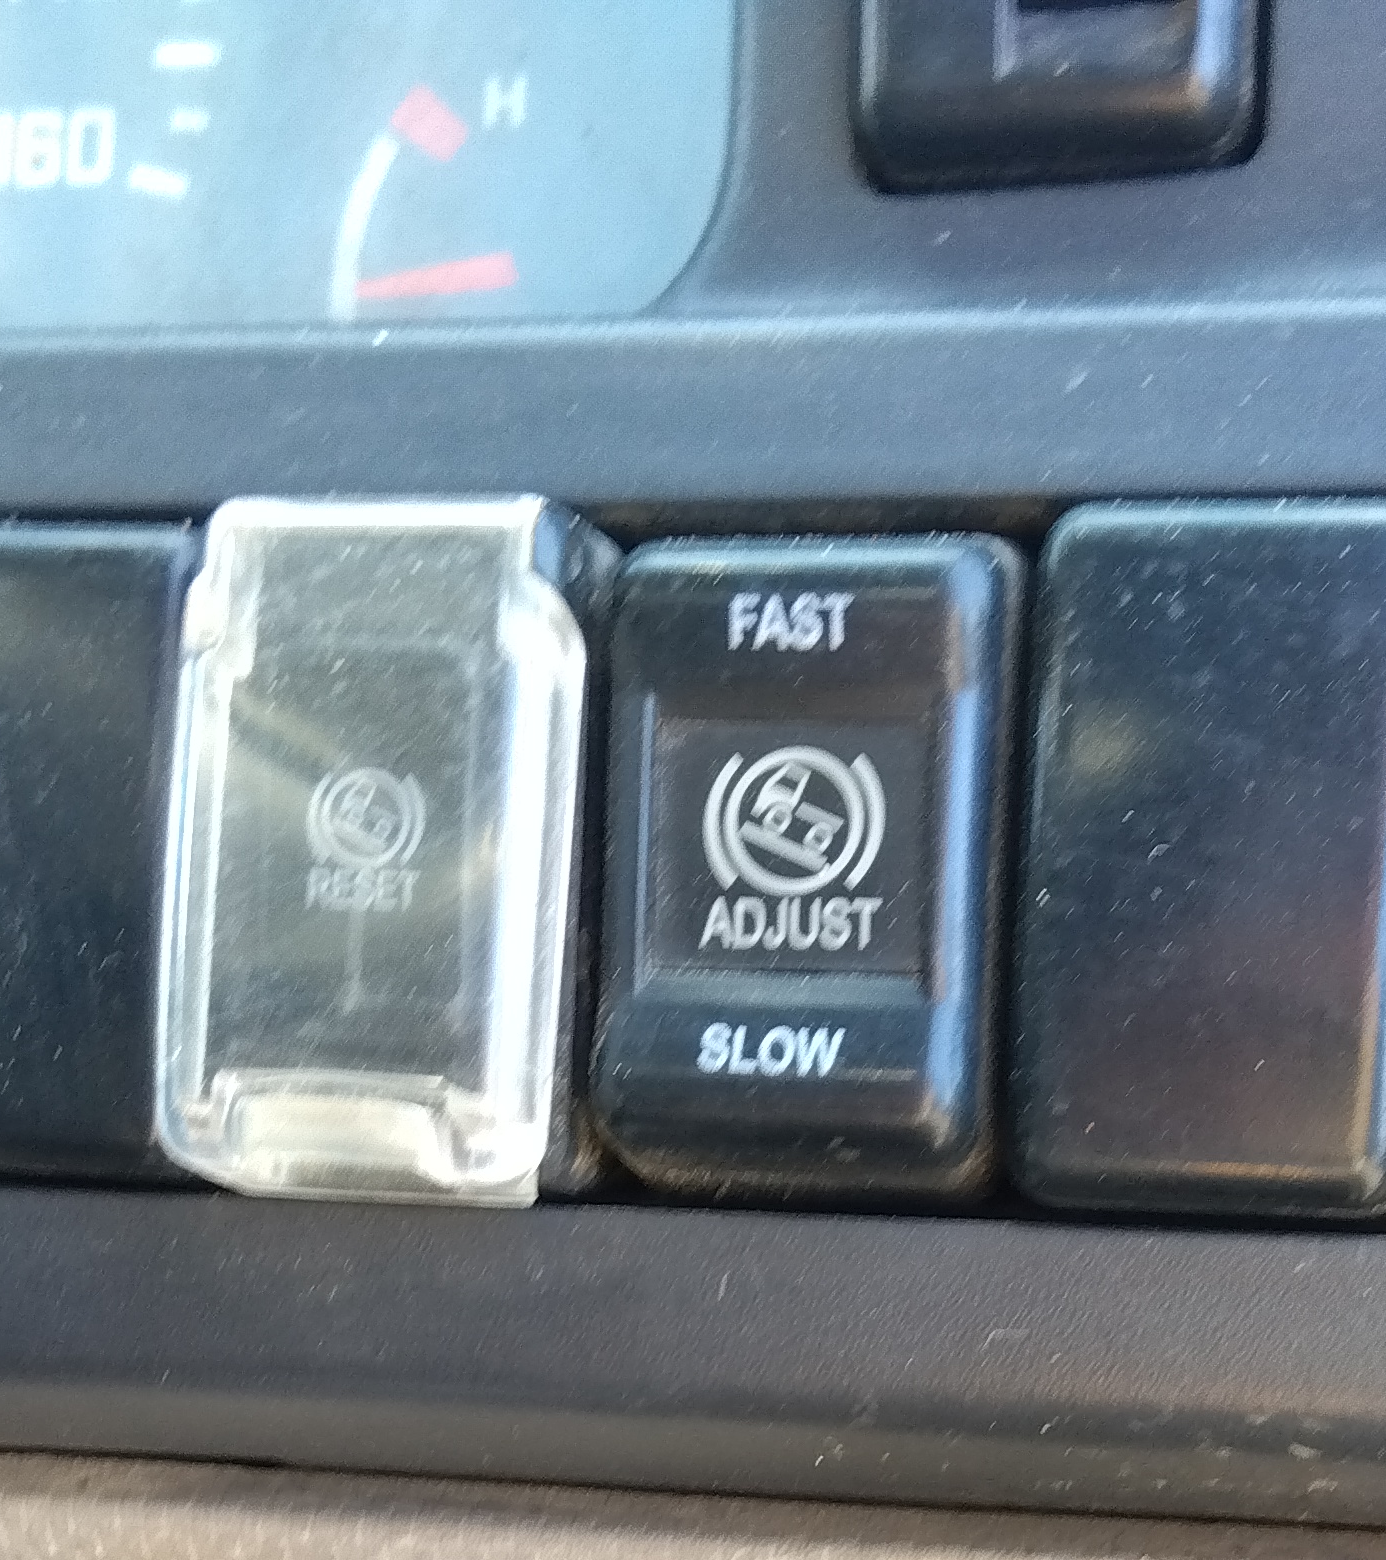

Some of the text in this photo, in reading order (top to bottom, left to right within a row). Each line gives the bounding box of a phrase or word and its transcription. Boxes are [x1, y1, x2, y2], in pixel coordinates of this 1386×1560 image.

[481, 73, 528, 131] H
[727, 591, 857, 652] FAST
[304, 866, 421, 913] RESET
[698, 895, 883, 951] ADJUST
[696, 1021, 847, 1078] SLOW
